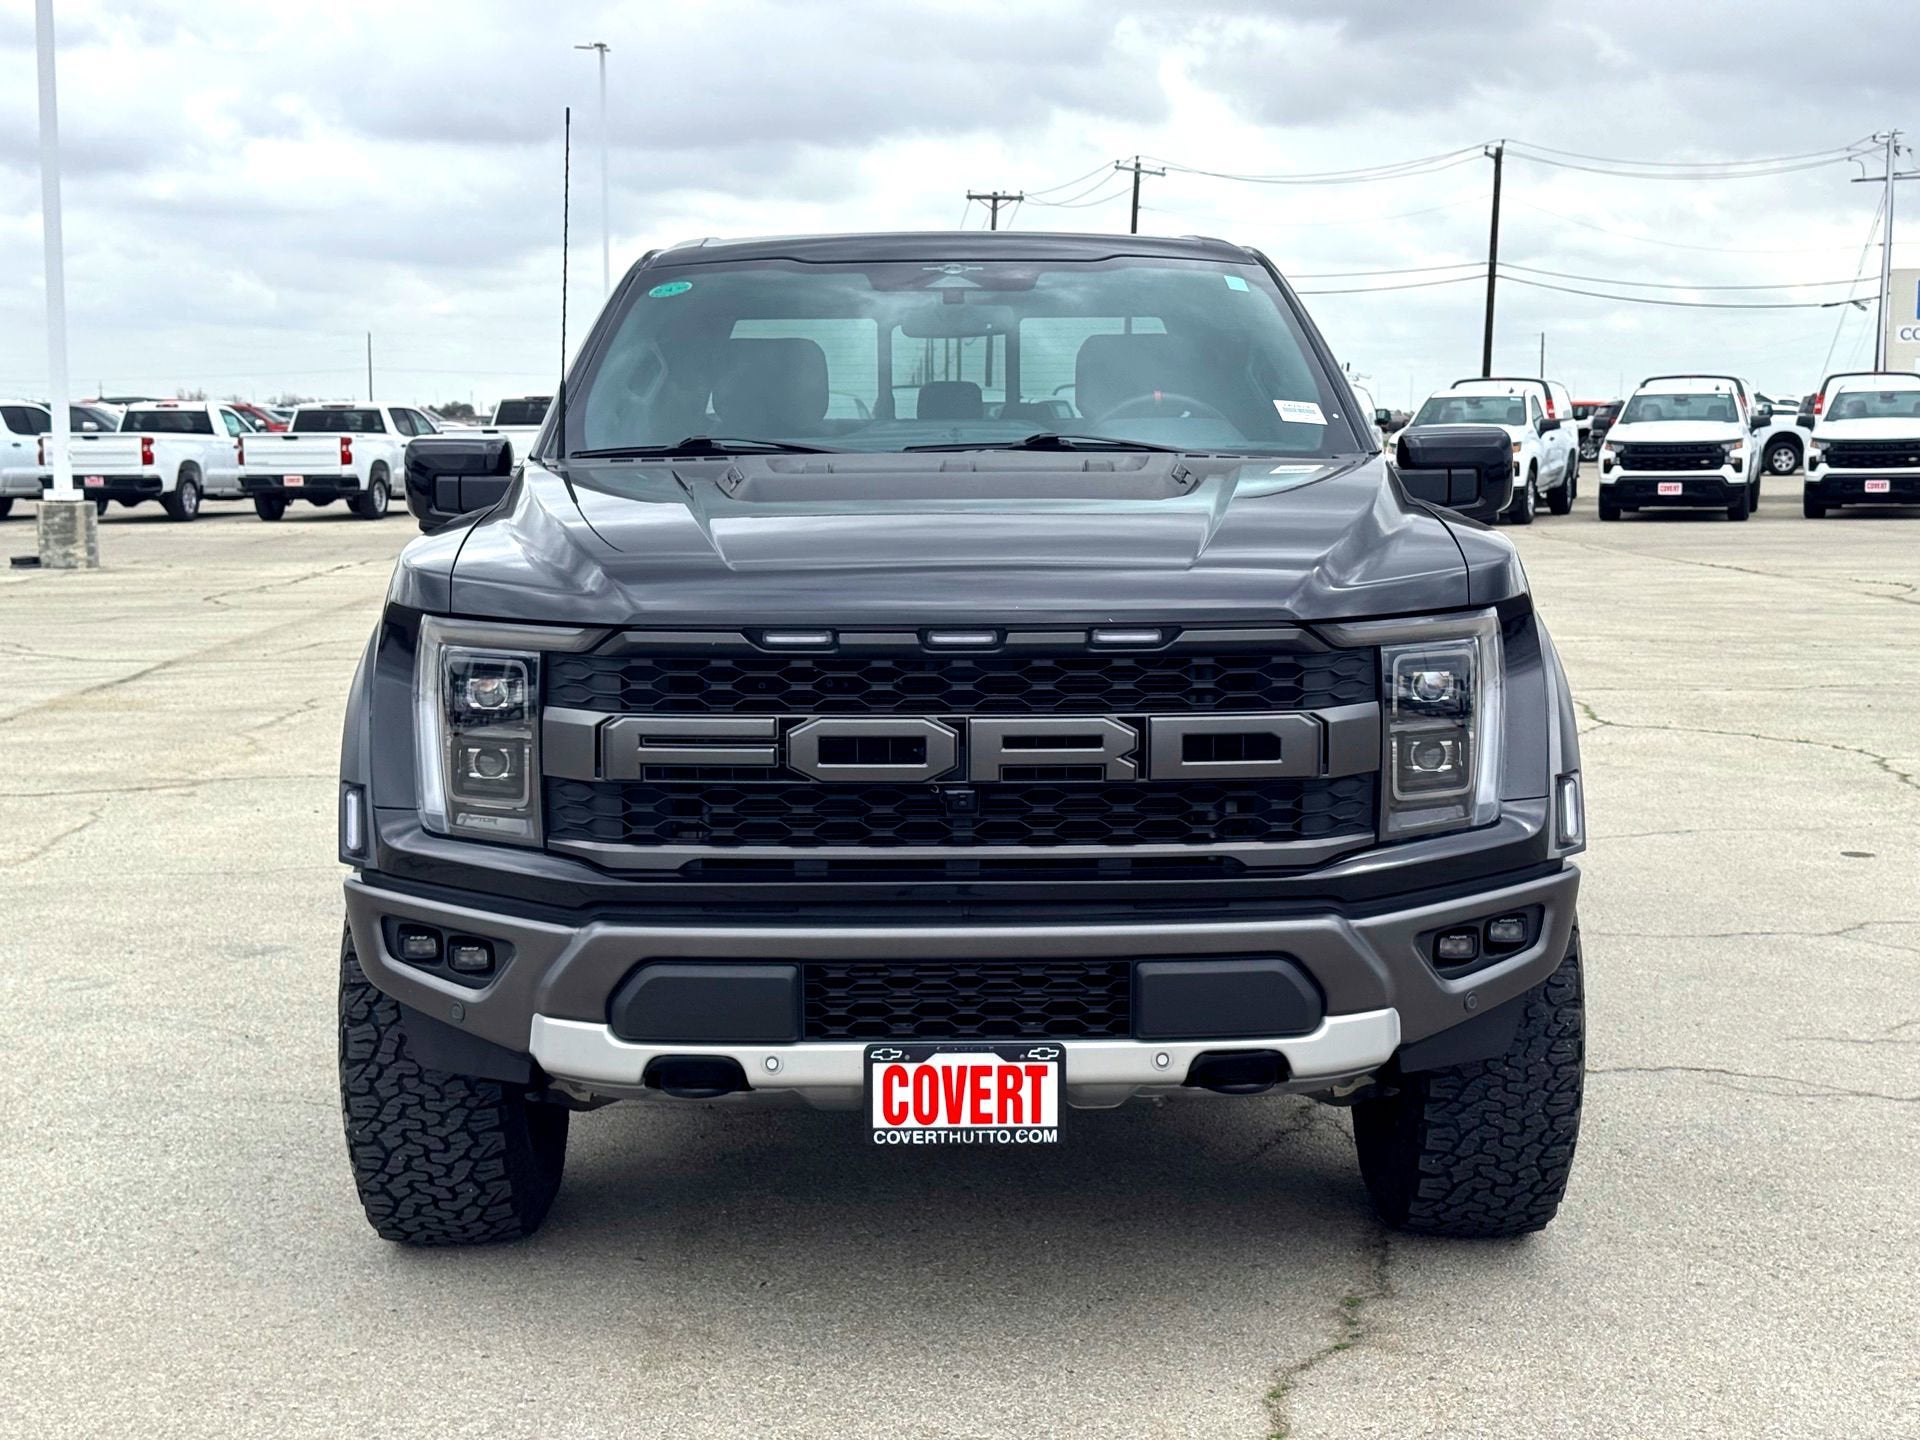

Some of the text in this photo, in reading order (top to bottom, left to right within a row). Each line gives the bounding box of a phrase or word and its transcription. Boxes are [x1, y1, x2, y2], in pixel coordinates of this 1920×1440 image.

[602, 714, 1320, 781] FORD
[883, 1064, 1048, 1126] COVERT
[873, 1129, 1058, 1145] COVERTHUTTO.COM
